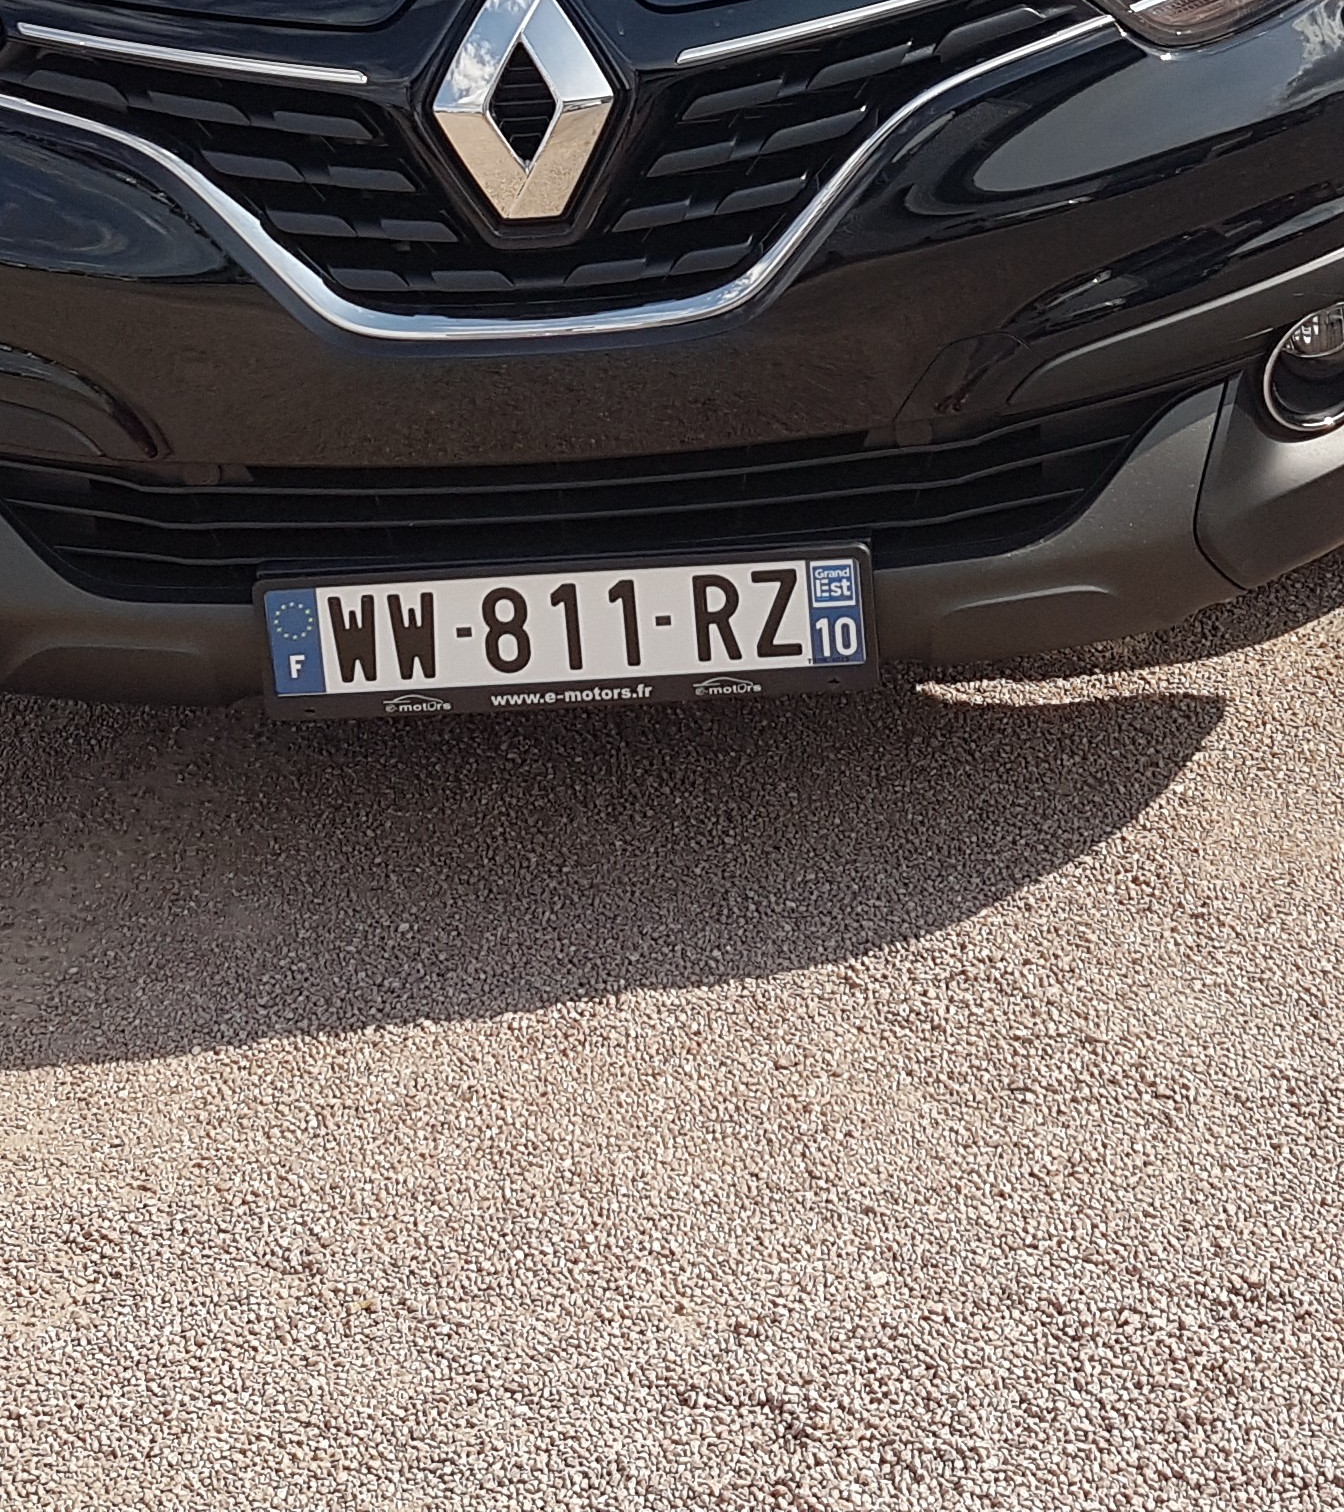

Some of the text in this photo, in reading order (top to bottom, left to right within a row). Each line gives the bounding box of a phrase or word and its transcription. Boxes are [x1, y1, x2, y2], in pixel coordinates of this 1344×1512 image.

[814, 567, 851, 580] Grand
[815, 578, 852, 598] Est
[326, 568, 803, 683] WW-811-RZ
[815, 616, 858, 657] 10
[289, 654, 306, 679] F
[490, 684, 653, 706] www.e-motors.fr
